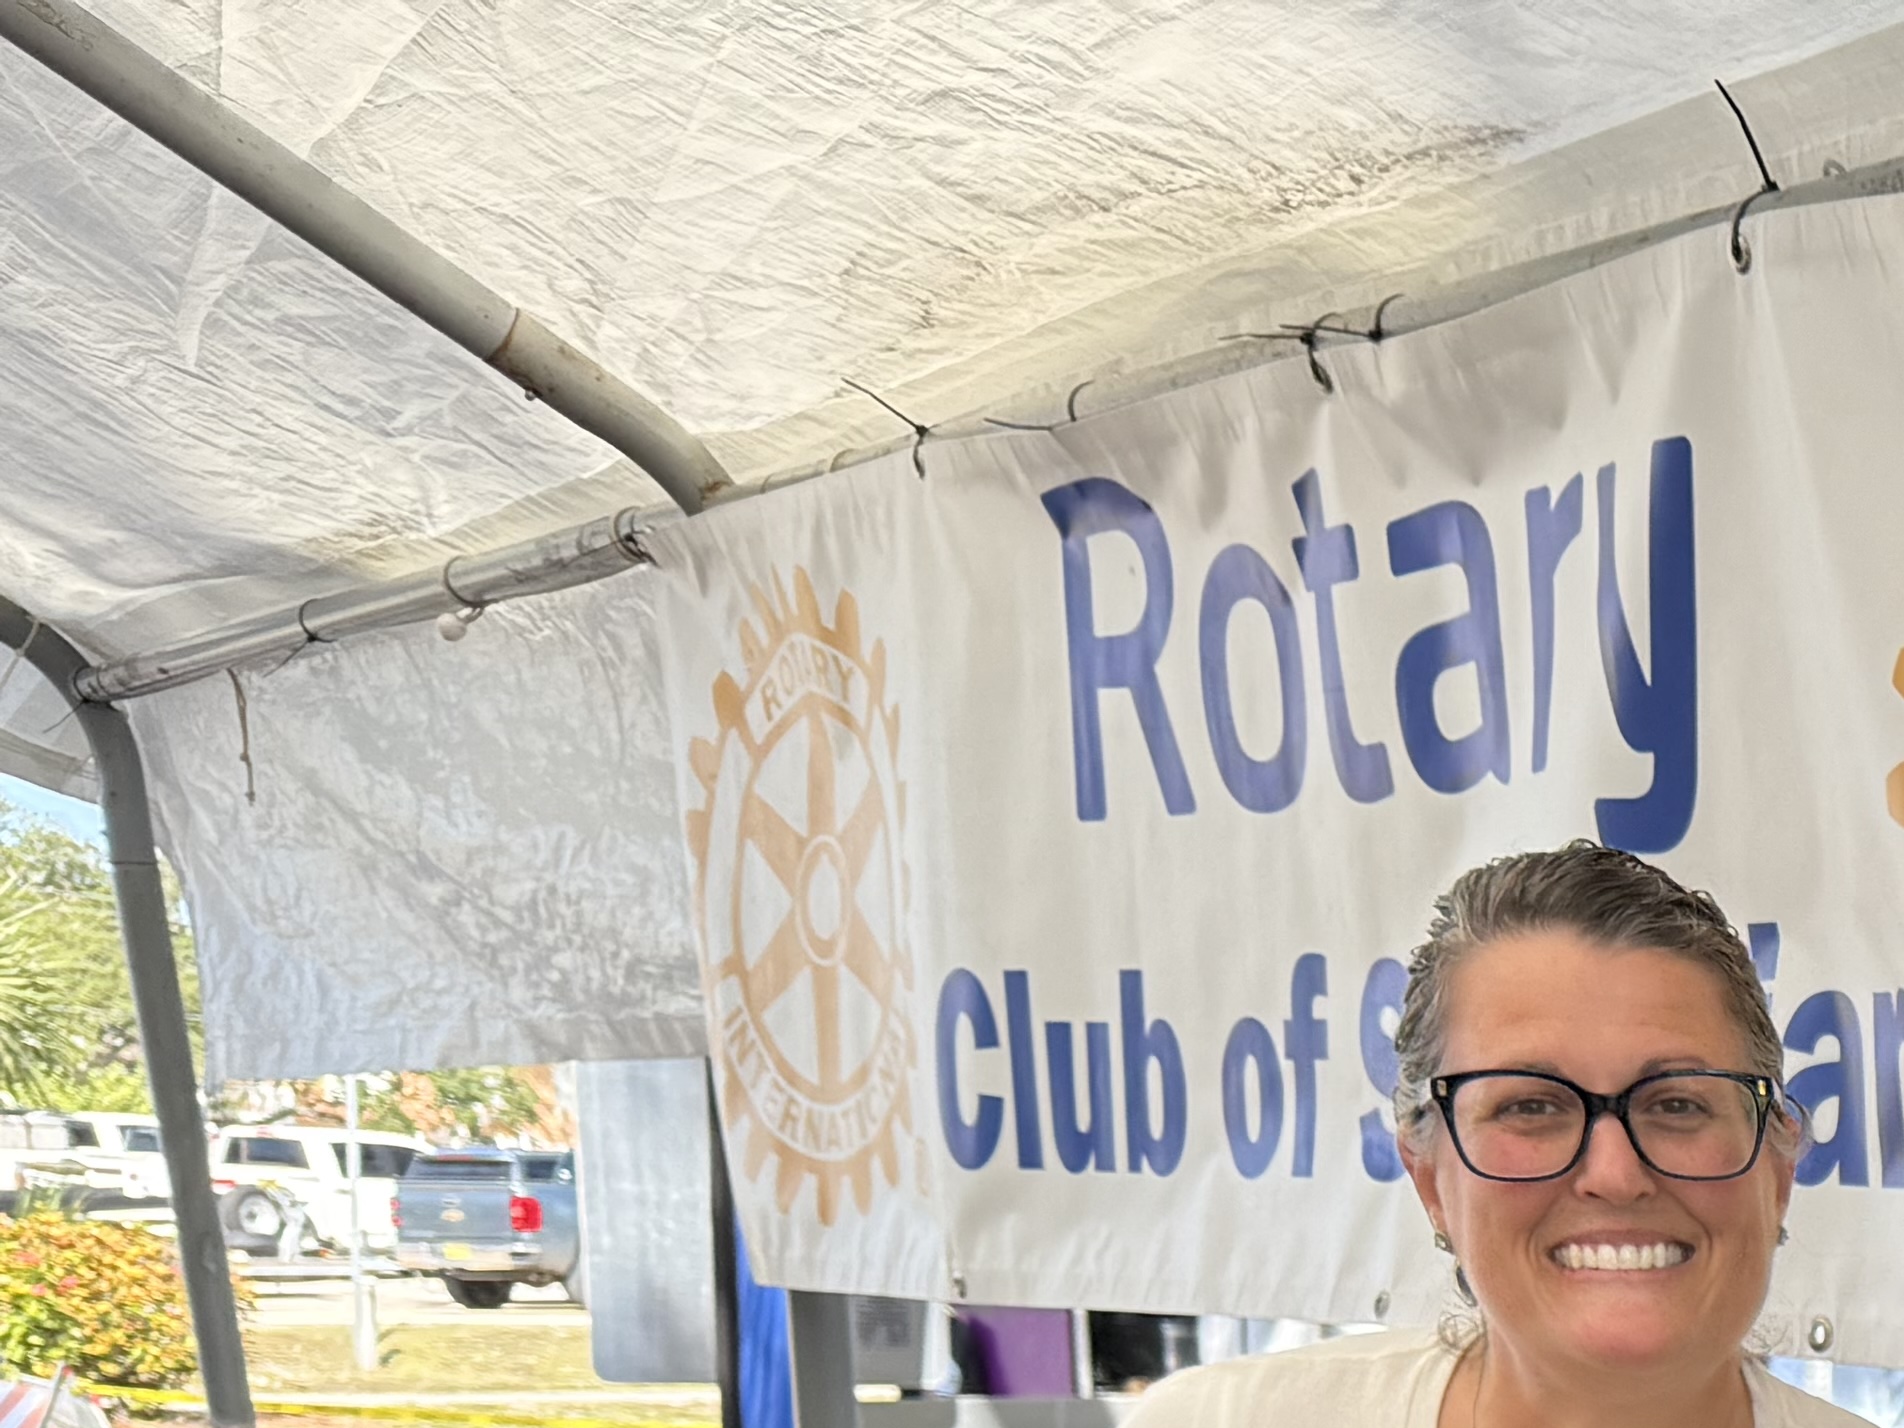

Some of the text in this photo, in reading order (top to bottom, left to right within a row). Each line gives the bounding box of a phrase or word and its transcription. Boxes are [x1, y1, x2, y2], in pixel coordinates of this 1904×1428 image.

[1040, 436, 1698, 855] Rotary
[936, 968, 1188, 1176] Club
[1222, 953, 1329, 1180] of
